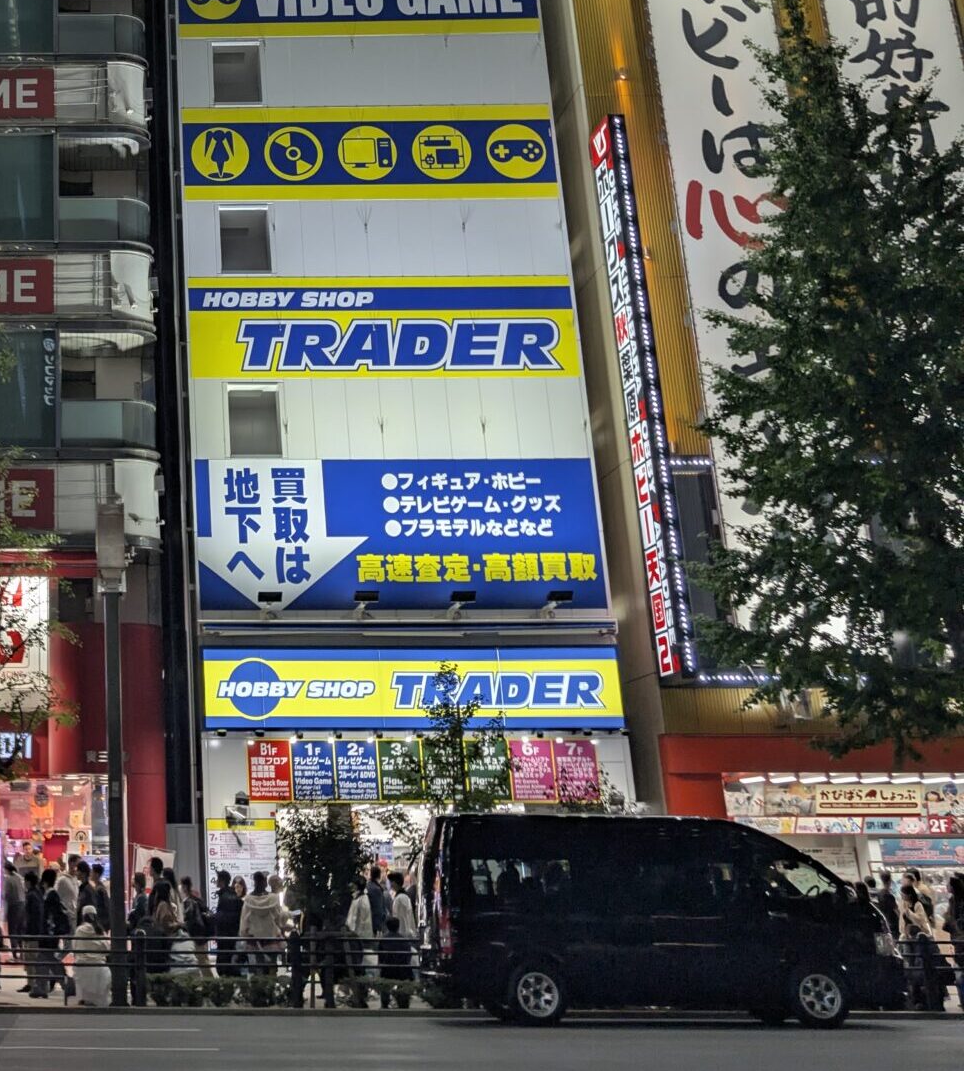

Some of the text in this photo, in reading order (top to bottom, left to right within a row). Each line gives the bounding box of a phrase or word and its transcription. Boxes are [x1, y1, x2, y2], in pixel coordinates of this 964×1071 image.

[203, 291, 374, 308] HOBBY SHOP
[236, 318, 564, 371] TRADER
[398, 472, 541, 491] フィギュア・ホビー
[400, 494, 562, 514] テレビゲーム・グッズ
[223, 467, 265, 581] 地下へ
[270, 466, 311, 585] 買取は
[402, 518, 553, 537] プラモデルなどなど
[356, 553, 598, 583] 高速査定・高額買取
[216, 670, 606, 710] HOBBY SHOP TRADER
[260, 743, 277, 756] B1F
[305, 743, 321, 756] 1F
[347, 743, 364, 756] 2F
[521, 742, 540, 756] 6F
[565, 742, 583, 756] 7F
[294, 757, 332, 765] テレビゲーム
[338, 757, 375, 765] テレビゲーム
[295, 777, 332, 785] Video Game
[929, 818, 948, 833] 2F
